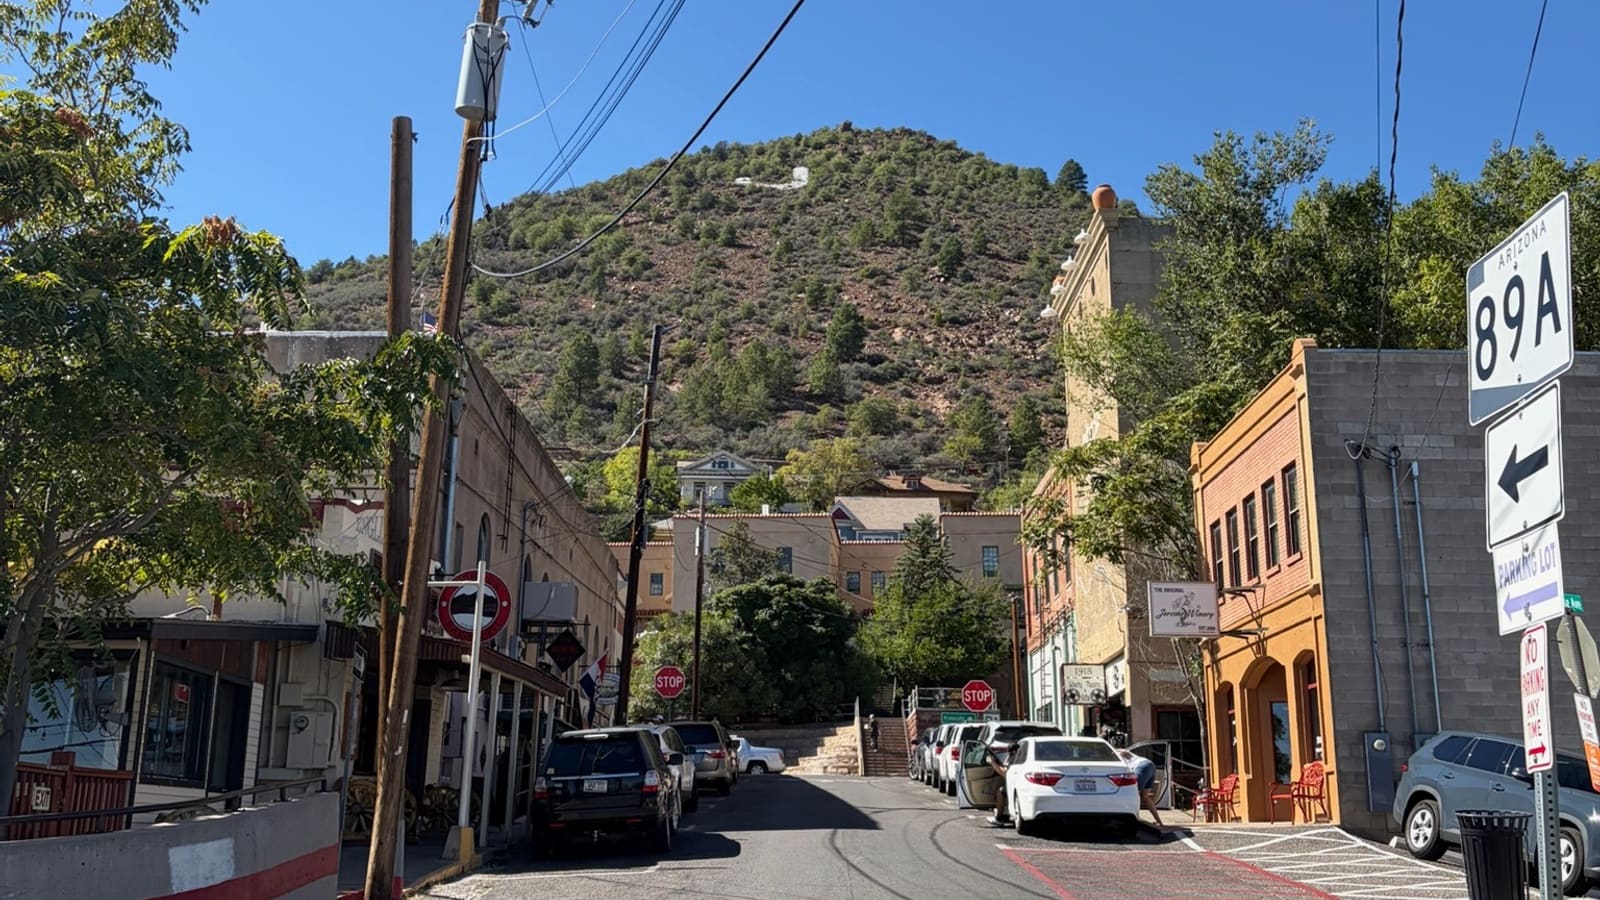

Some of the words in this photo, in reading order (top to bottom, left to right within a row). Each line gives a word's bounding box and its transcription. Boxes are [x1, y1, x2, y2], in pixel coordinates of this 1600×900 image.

[1498, 219, 1547, 269] ARIZONA
[1475, 250, 1561, 382] 89A
[1497, 551, 1537, 589] PARKING
[1539, 542, 1556, 573] LOT
[1524, 638, 1538, 665] NO
[656, 676, 683, 685] STOP
[1522, 666, 1544, 697] PARKING
[964, 690, 990, 702] STOP
[1527, 699, 1540, 717] ANY
[1527, 720, 1542, 739] TIME
